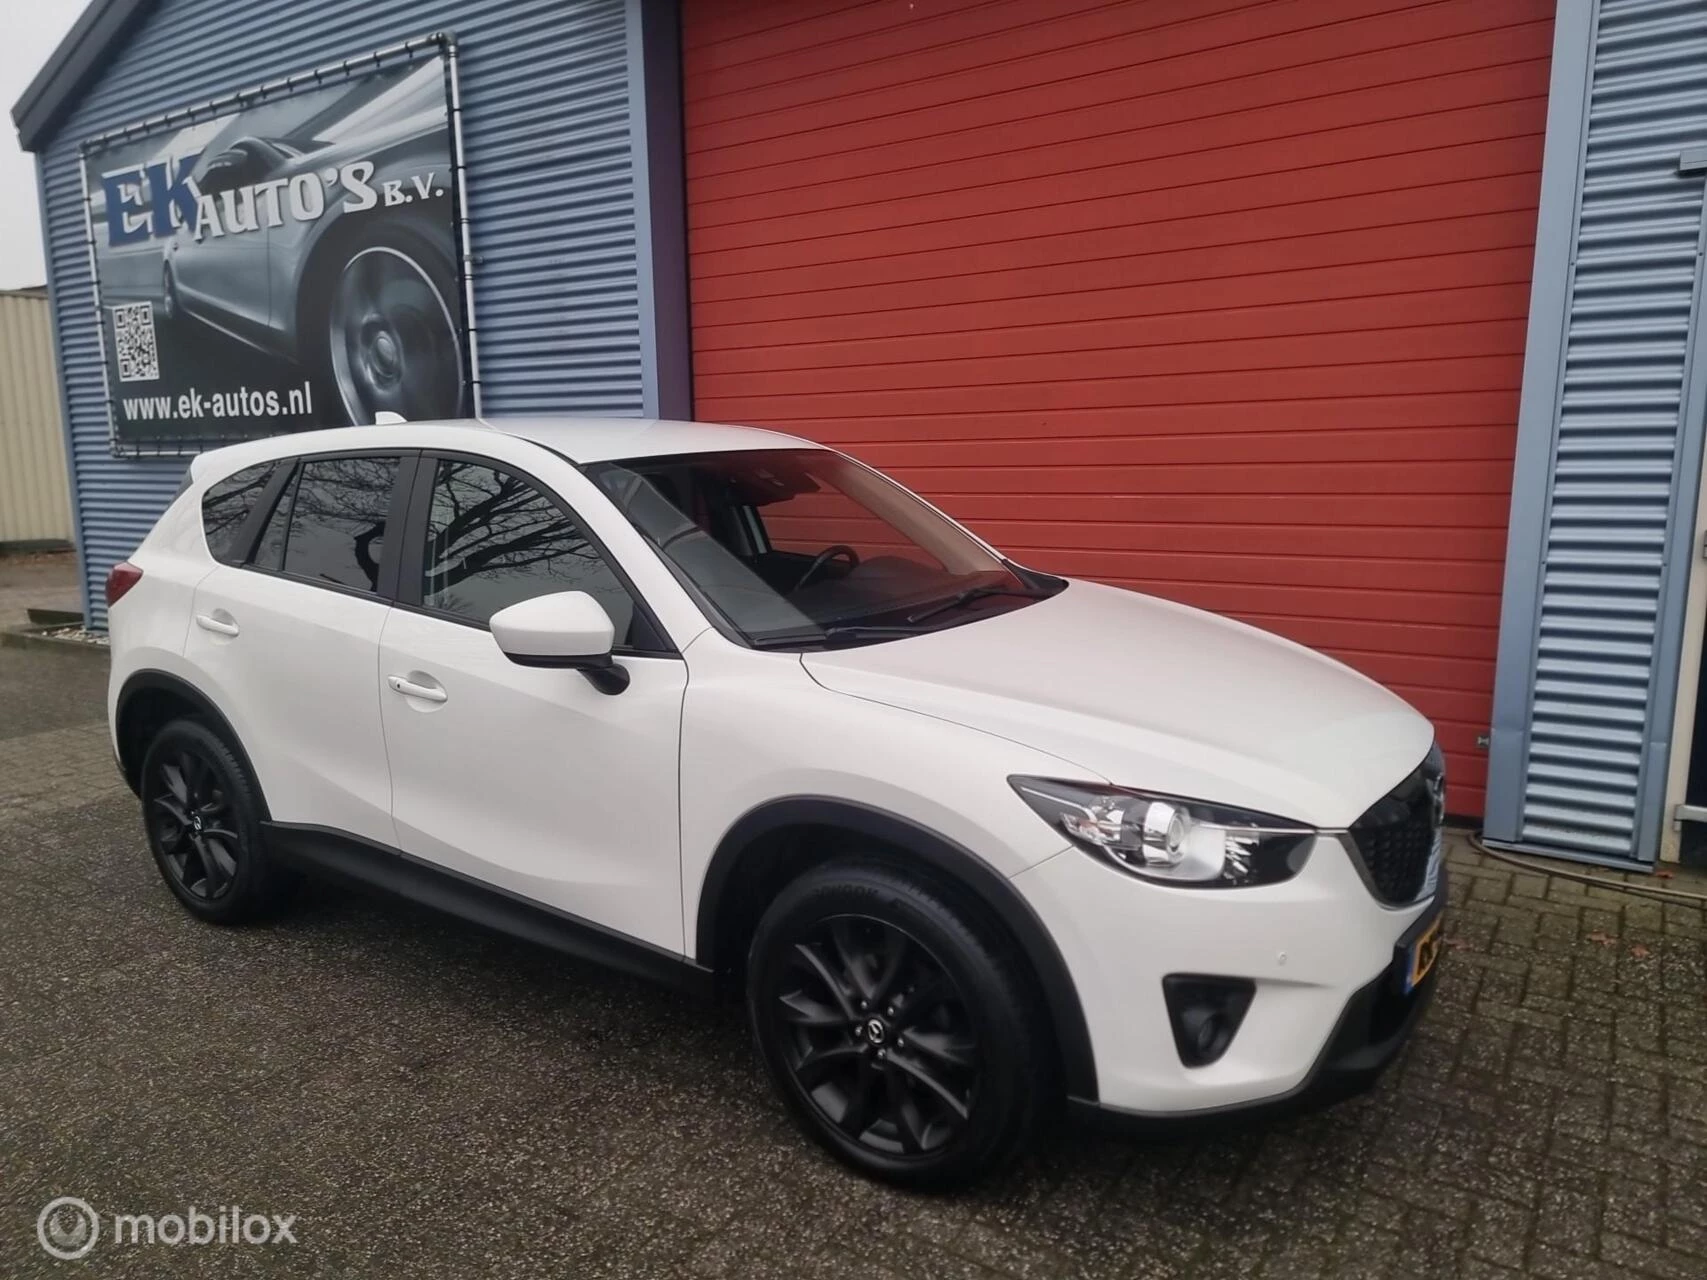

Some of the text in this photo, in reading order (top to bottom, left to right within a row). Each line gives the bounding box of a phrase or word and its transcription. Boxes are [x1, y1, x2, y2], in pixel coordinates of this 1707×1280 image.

[101, 151, 444, 247] EK AUTO'S B.V.
[123, 380, 312, 421] www.ek-autos.nl
